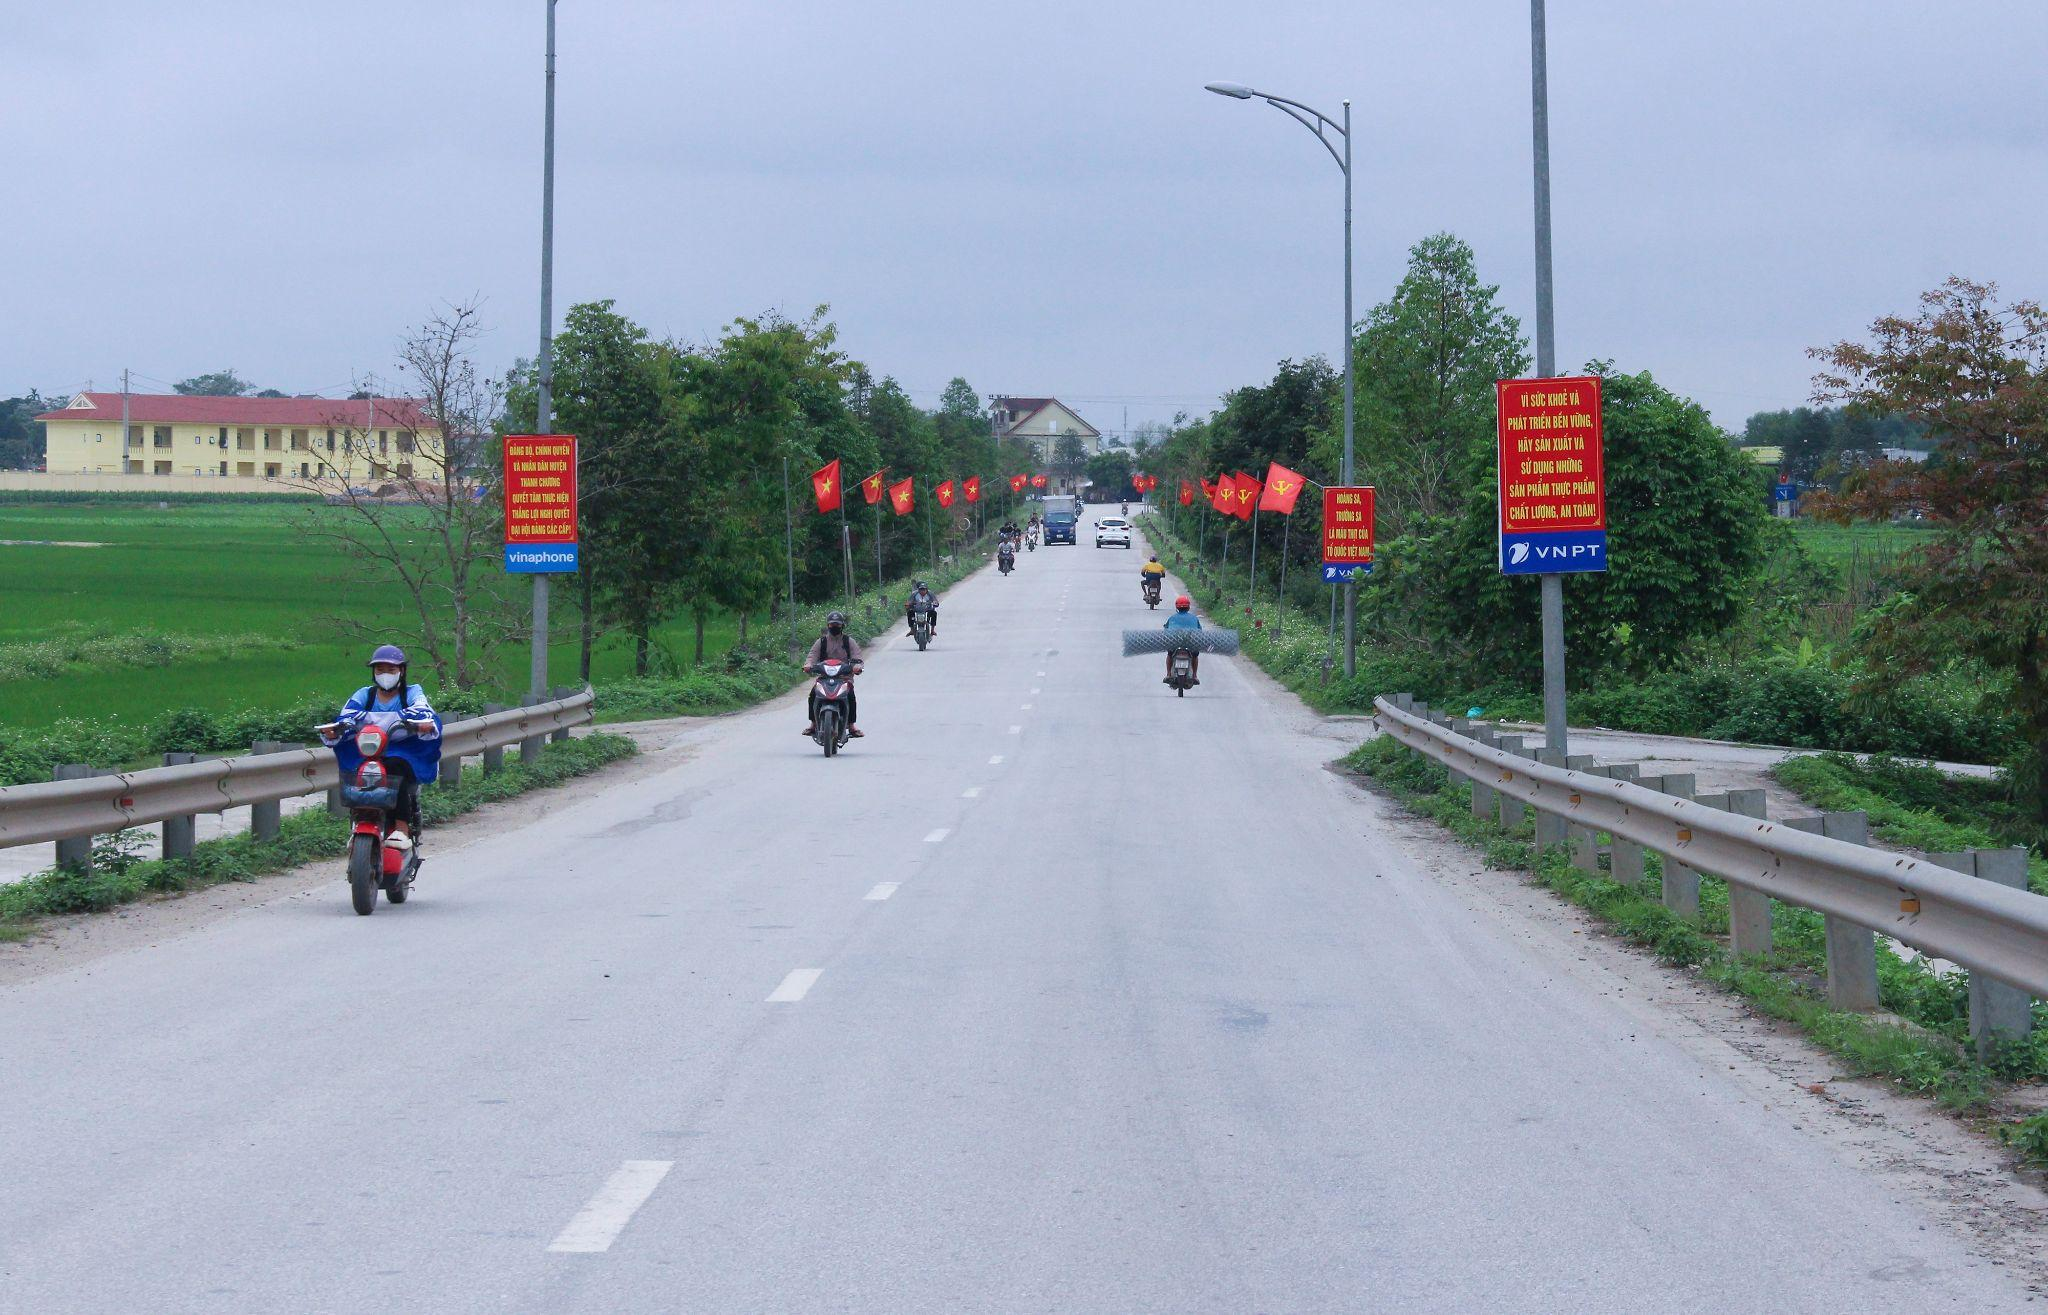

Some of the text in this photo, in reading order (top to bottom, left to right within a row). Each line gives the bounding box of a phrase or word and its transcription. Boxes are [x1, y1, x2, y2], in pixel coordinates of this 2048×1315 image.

[1521, 388, 1580, 408] VÌ SỨC KHOẺ VÀ
[1508, 414, 1528, 430] PHÁT
[1529, 410, 1550, 430] TRIỂN
[1570, 412, 1593, 429] VỮNG,
[1518, 433, 1584, 452] HÃY SẢN XUẤT VÀ
[522, 460, 536, 471] NHÂN
[538, 460, 548, 471] DÂN
[550, 460, 567, 473] HUYỆN
[1521, 457, 1532, 474] SỬ
[1556, 457, 1583, 473] NHỮNG
[520, 476, 560, 487] THANH CHƯƠNG
[1510, 476, 1595, 498] SẢN PHẨM THỰC PHẨM
[542, 493, 556, 504] THỰC
[556, 491, 569, 504] HIỆN
[540, 510, 552, 520] NGHỊ
[554, 506, 570, 519] QUYẾT
[1356, 511, 1362, 522] SA
[1510, 501, 1596, 522] CHẤT LƯỢNG, AN TOÀN!
[547, 523, 558, 534] CÁC
[509, 552, 574, 564] vinaphone
[1348, 544, 1358, 559] VIỆT
[1535, 544, 1600, 558] VNPT
